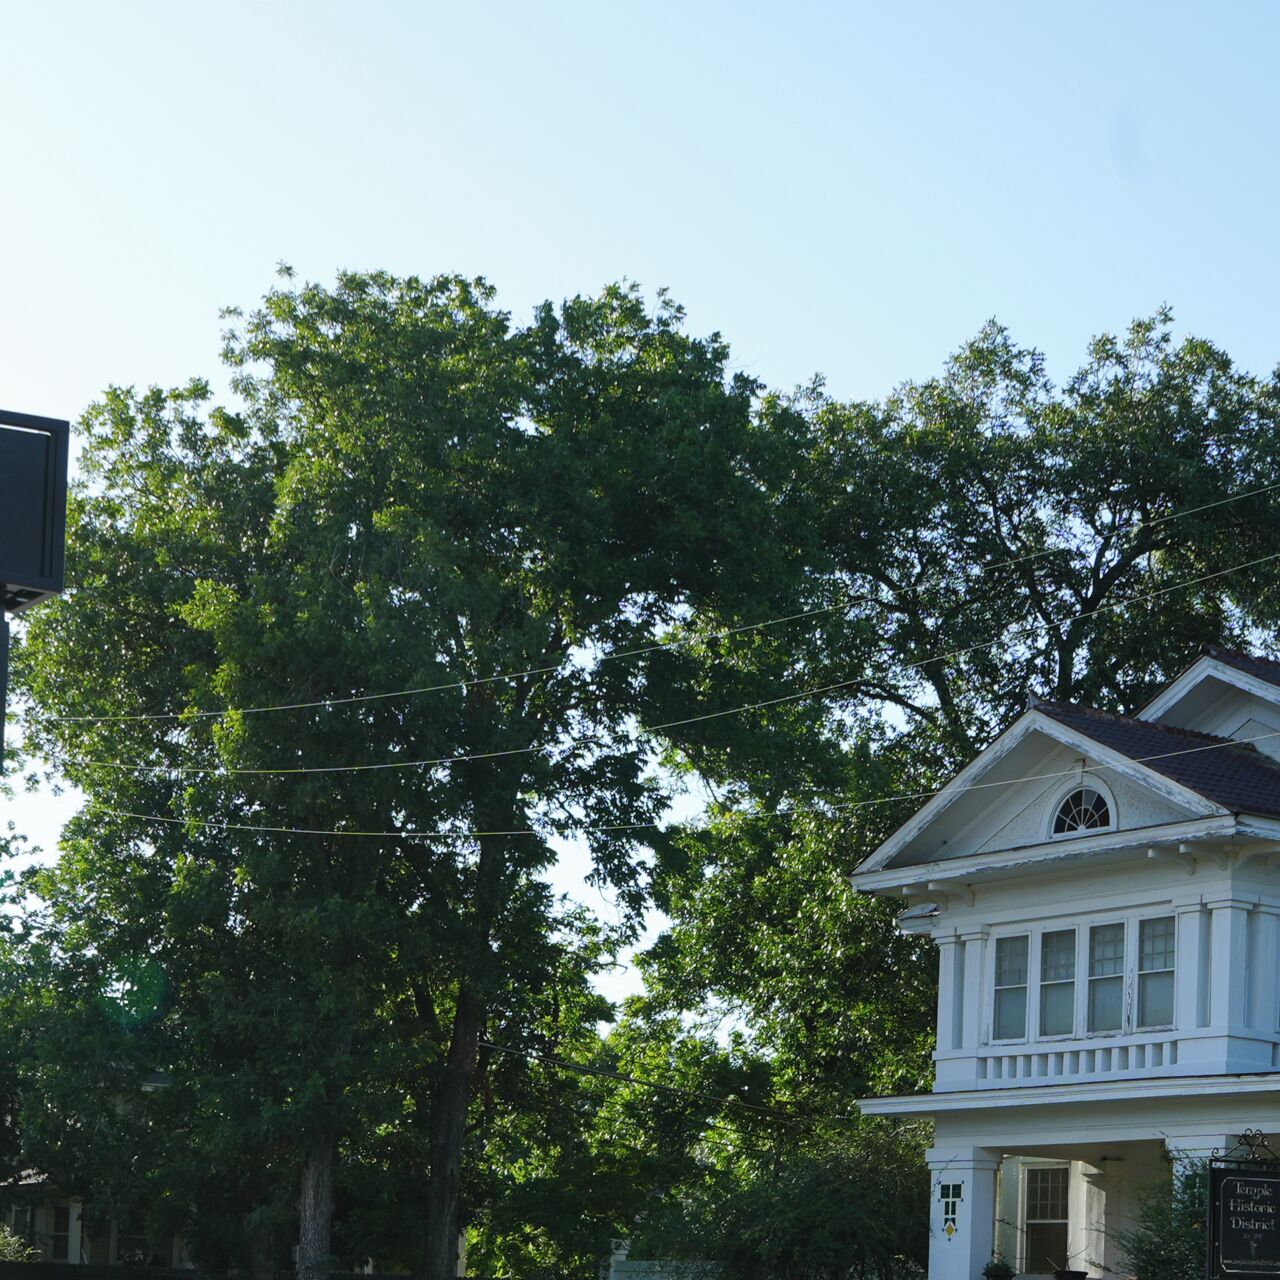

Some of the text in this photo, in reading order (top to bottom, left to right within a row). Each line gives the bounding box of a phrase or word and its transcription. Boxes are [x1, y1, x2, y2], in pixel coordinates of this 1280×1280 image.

[1233, 1182, 1272, 1199] Temple
[1229, 1199, 1276, 1213] Historic
[1231, 1217, 1276, 1230] District
